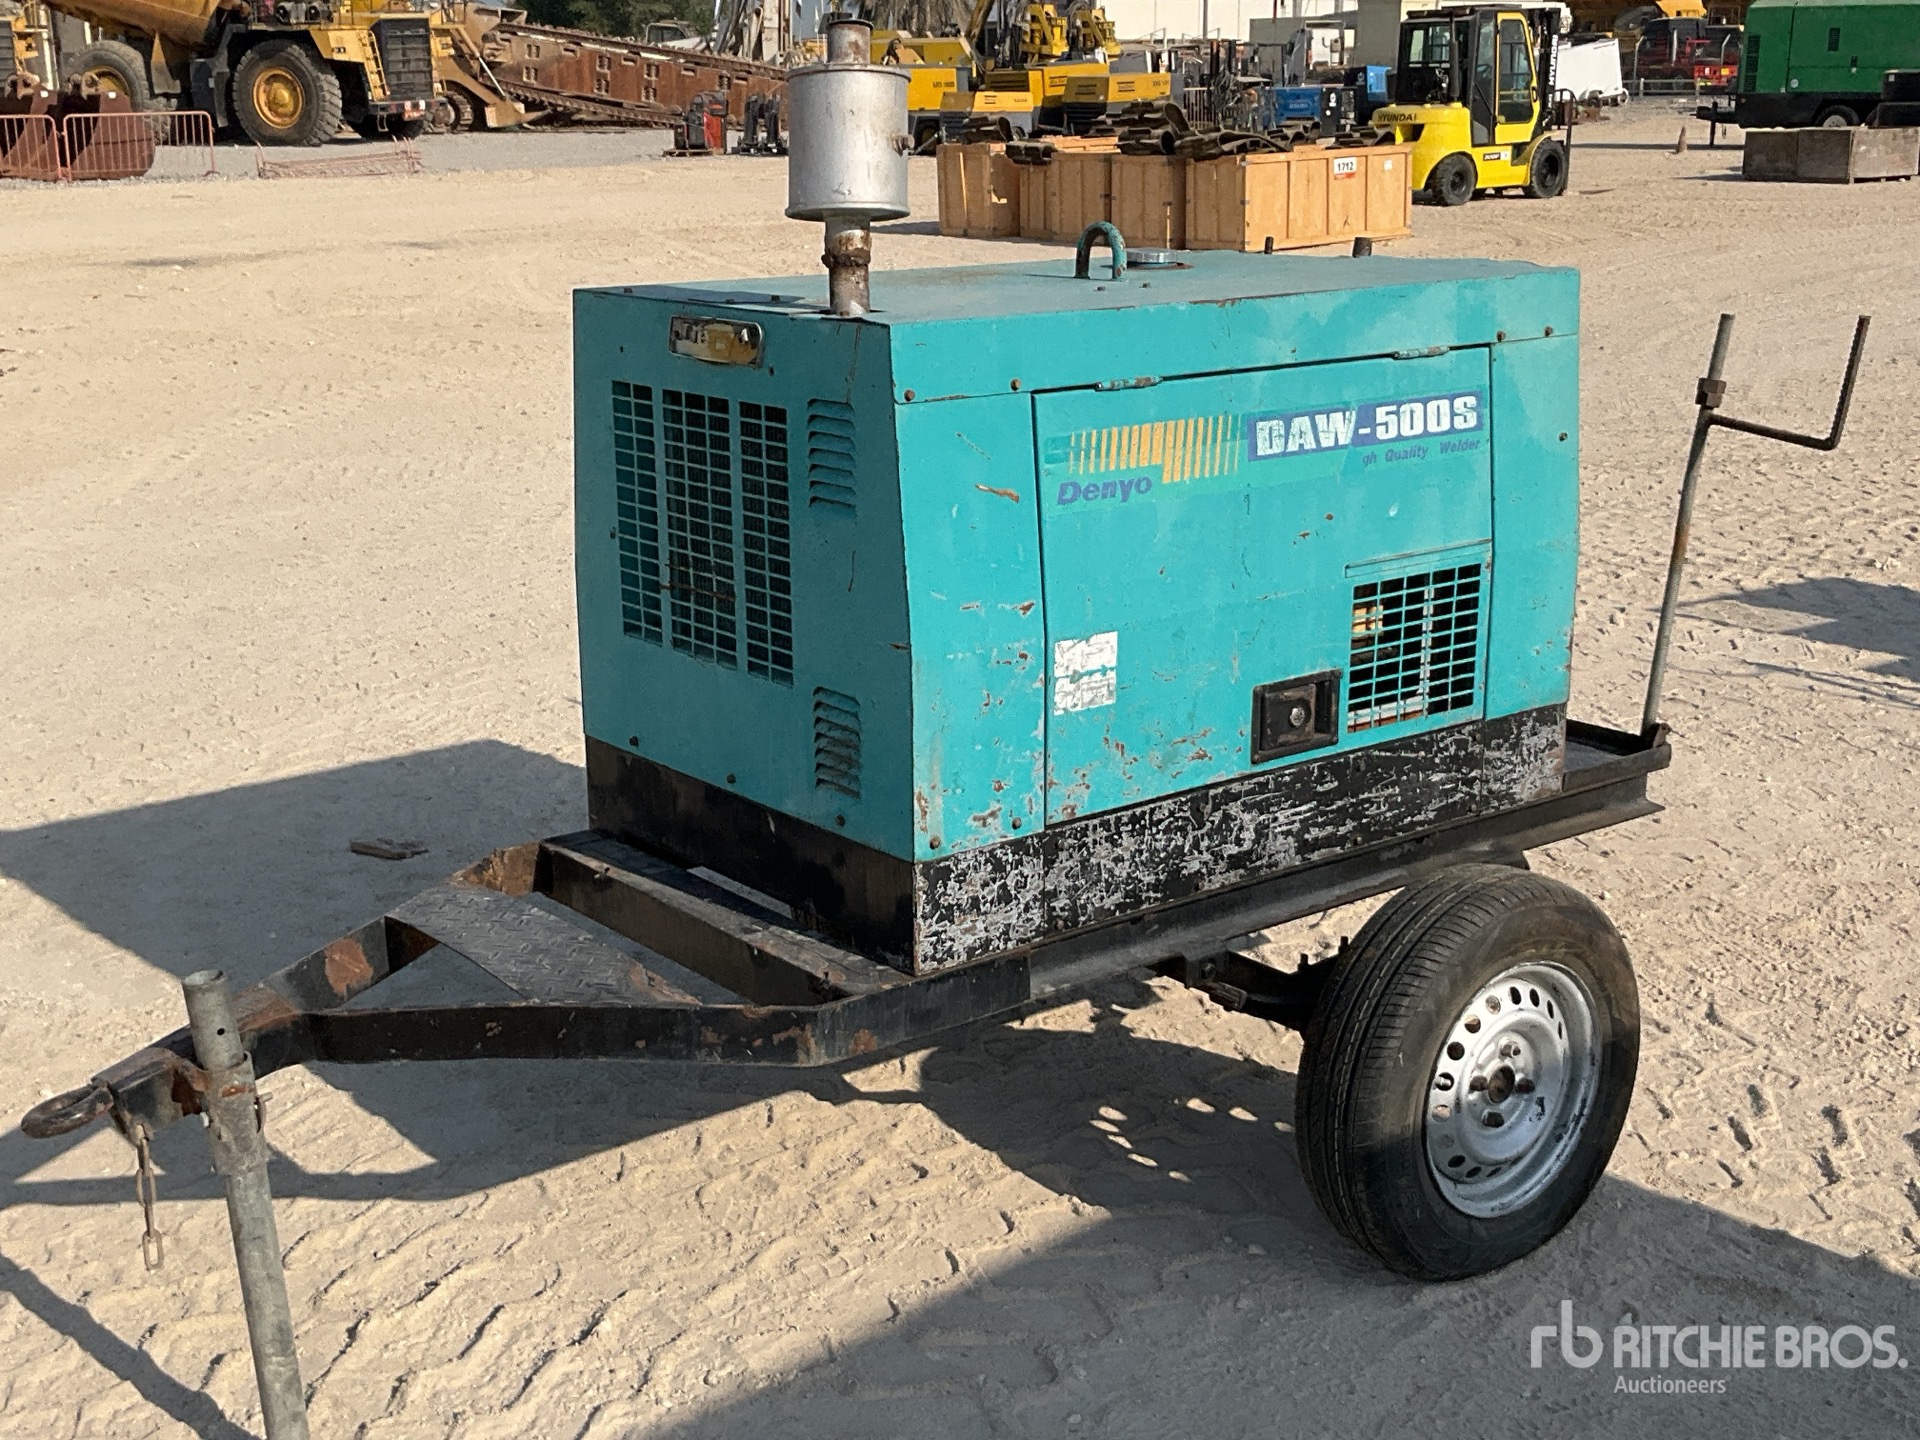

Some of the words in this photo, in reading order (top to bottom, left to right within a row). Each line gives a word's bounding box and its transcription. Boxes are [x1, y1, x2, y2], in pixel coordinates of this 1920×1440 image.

[1379, 112, 1417, 122] HYUNDAI
[1337, 161, 1354, 171] 1712
[1256, 396, 1477, 456] DAW-500S
[1385, 444, 1428, 462] Quality
[1440, 438, 1480, 454] Welder
[1057, 476, 1153, 506] Denyo
